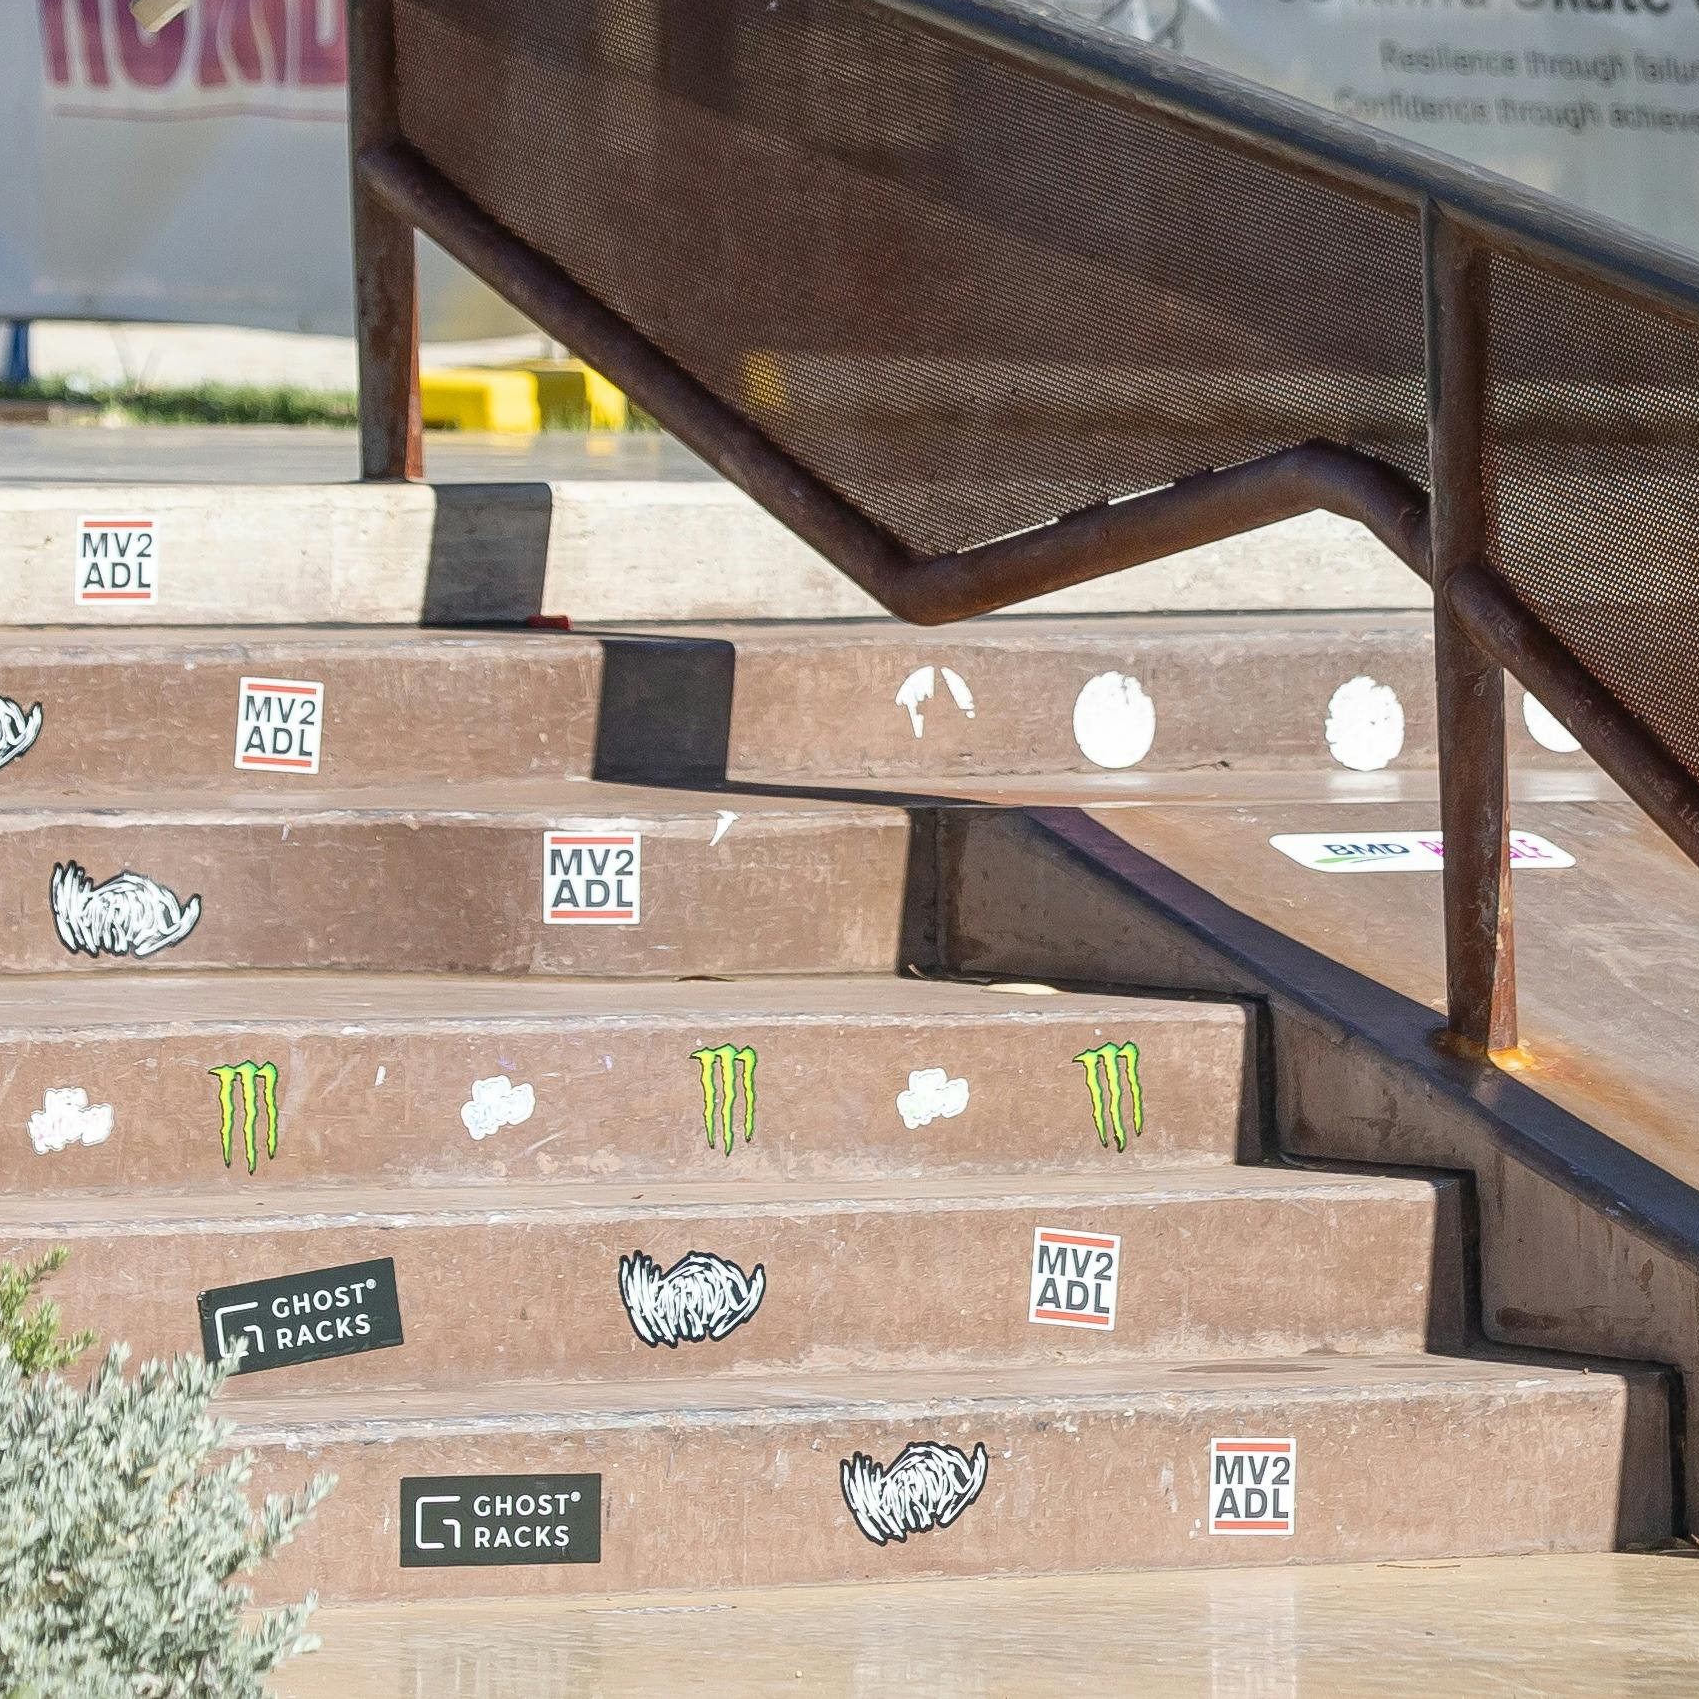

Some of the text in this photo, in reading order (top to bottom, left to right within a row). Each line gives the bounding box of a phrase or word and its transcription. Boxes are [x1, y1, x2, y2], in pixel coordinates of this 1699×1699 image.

[82, 532, 153, 558] MV2
[83, 562, 151, 589] ADL
[245, 695, 316, 725] MV2
[244, 725, 313, 757] ADL
[550, 849, 634, 876] MV2
[1323, 844, 1411, 856] BMD
[551, 879, 634, 907] ADL
[1037, 1245, 1113, 1281] MV2
[1036, 1277, 1110, 1314] ADL
[276, 1314, 371, 1350] RACKS
[1215, 1455, 1290, 1485] MV2
[1215, 1487, 1289, 1518] ADL
[474, 1525, 570, 1548] RACKS
